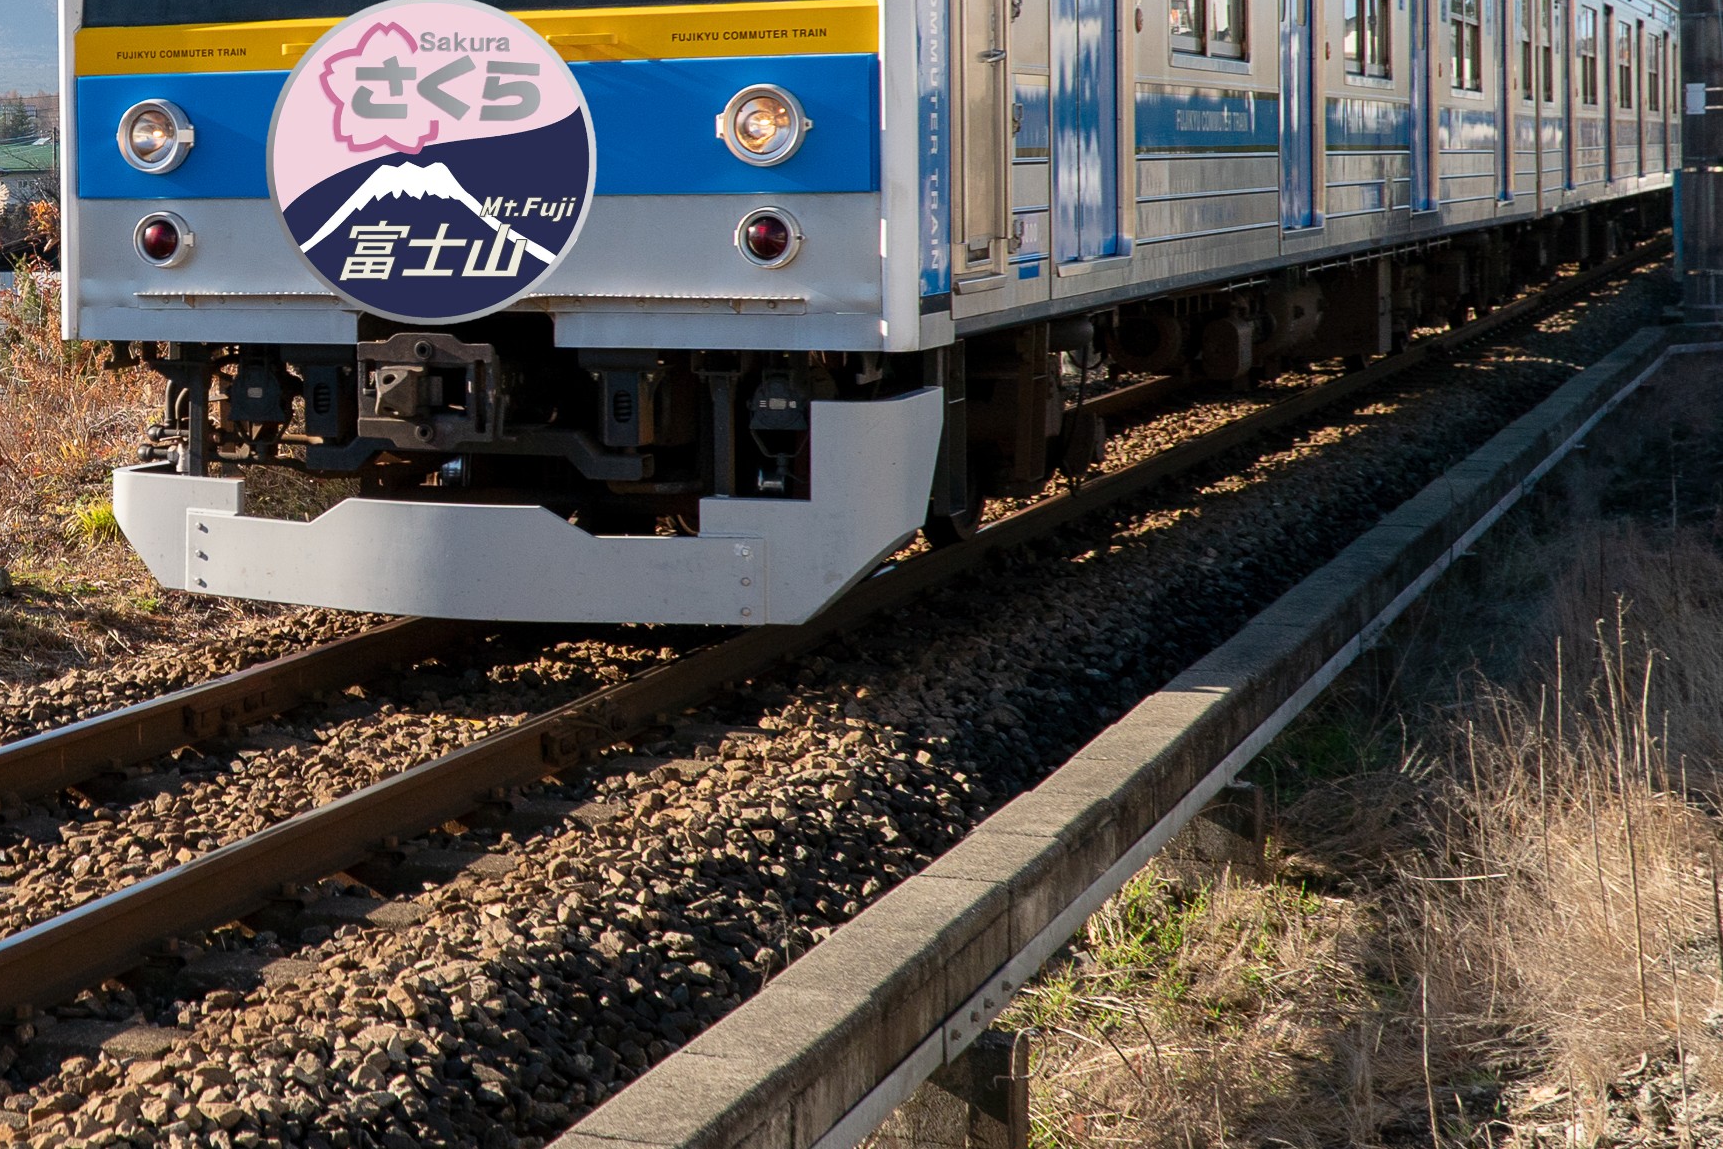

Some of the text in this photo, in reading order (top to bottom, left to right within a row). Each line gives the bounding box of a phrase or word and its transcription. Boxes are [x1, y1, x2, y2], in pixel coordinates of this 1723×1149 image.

[419, 31, 510, 52] Sakura
[671, 27, 827, 42] FUJIKYU COMMUTER TRAIN
[116, 47, 247, 60] FUJIKYU COMMUTER TRAIN
[351, 54, 541, 122] さくら
[480, 196, 577, 222] Mt.Fuji
[339, 220, 528, 282] 富士山
